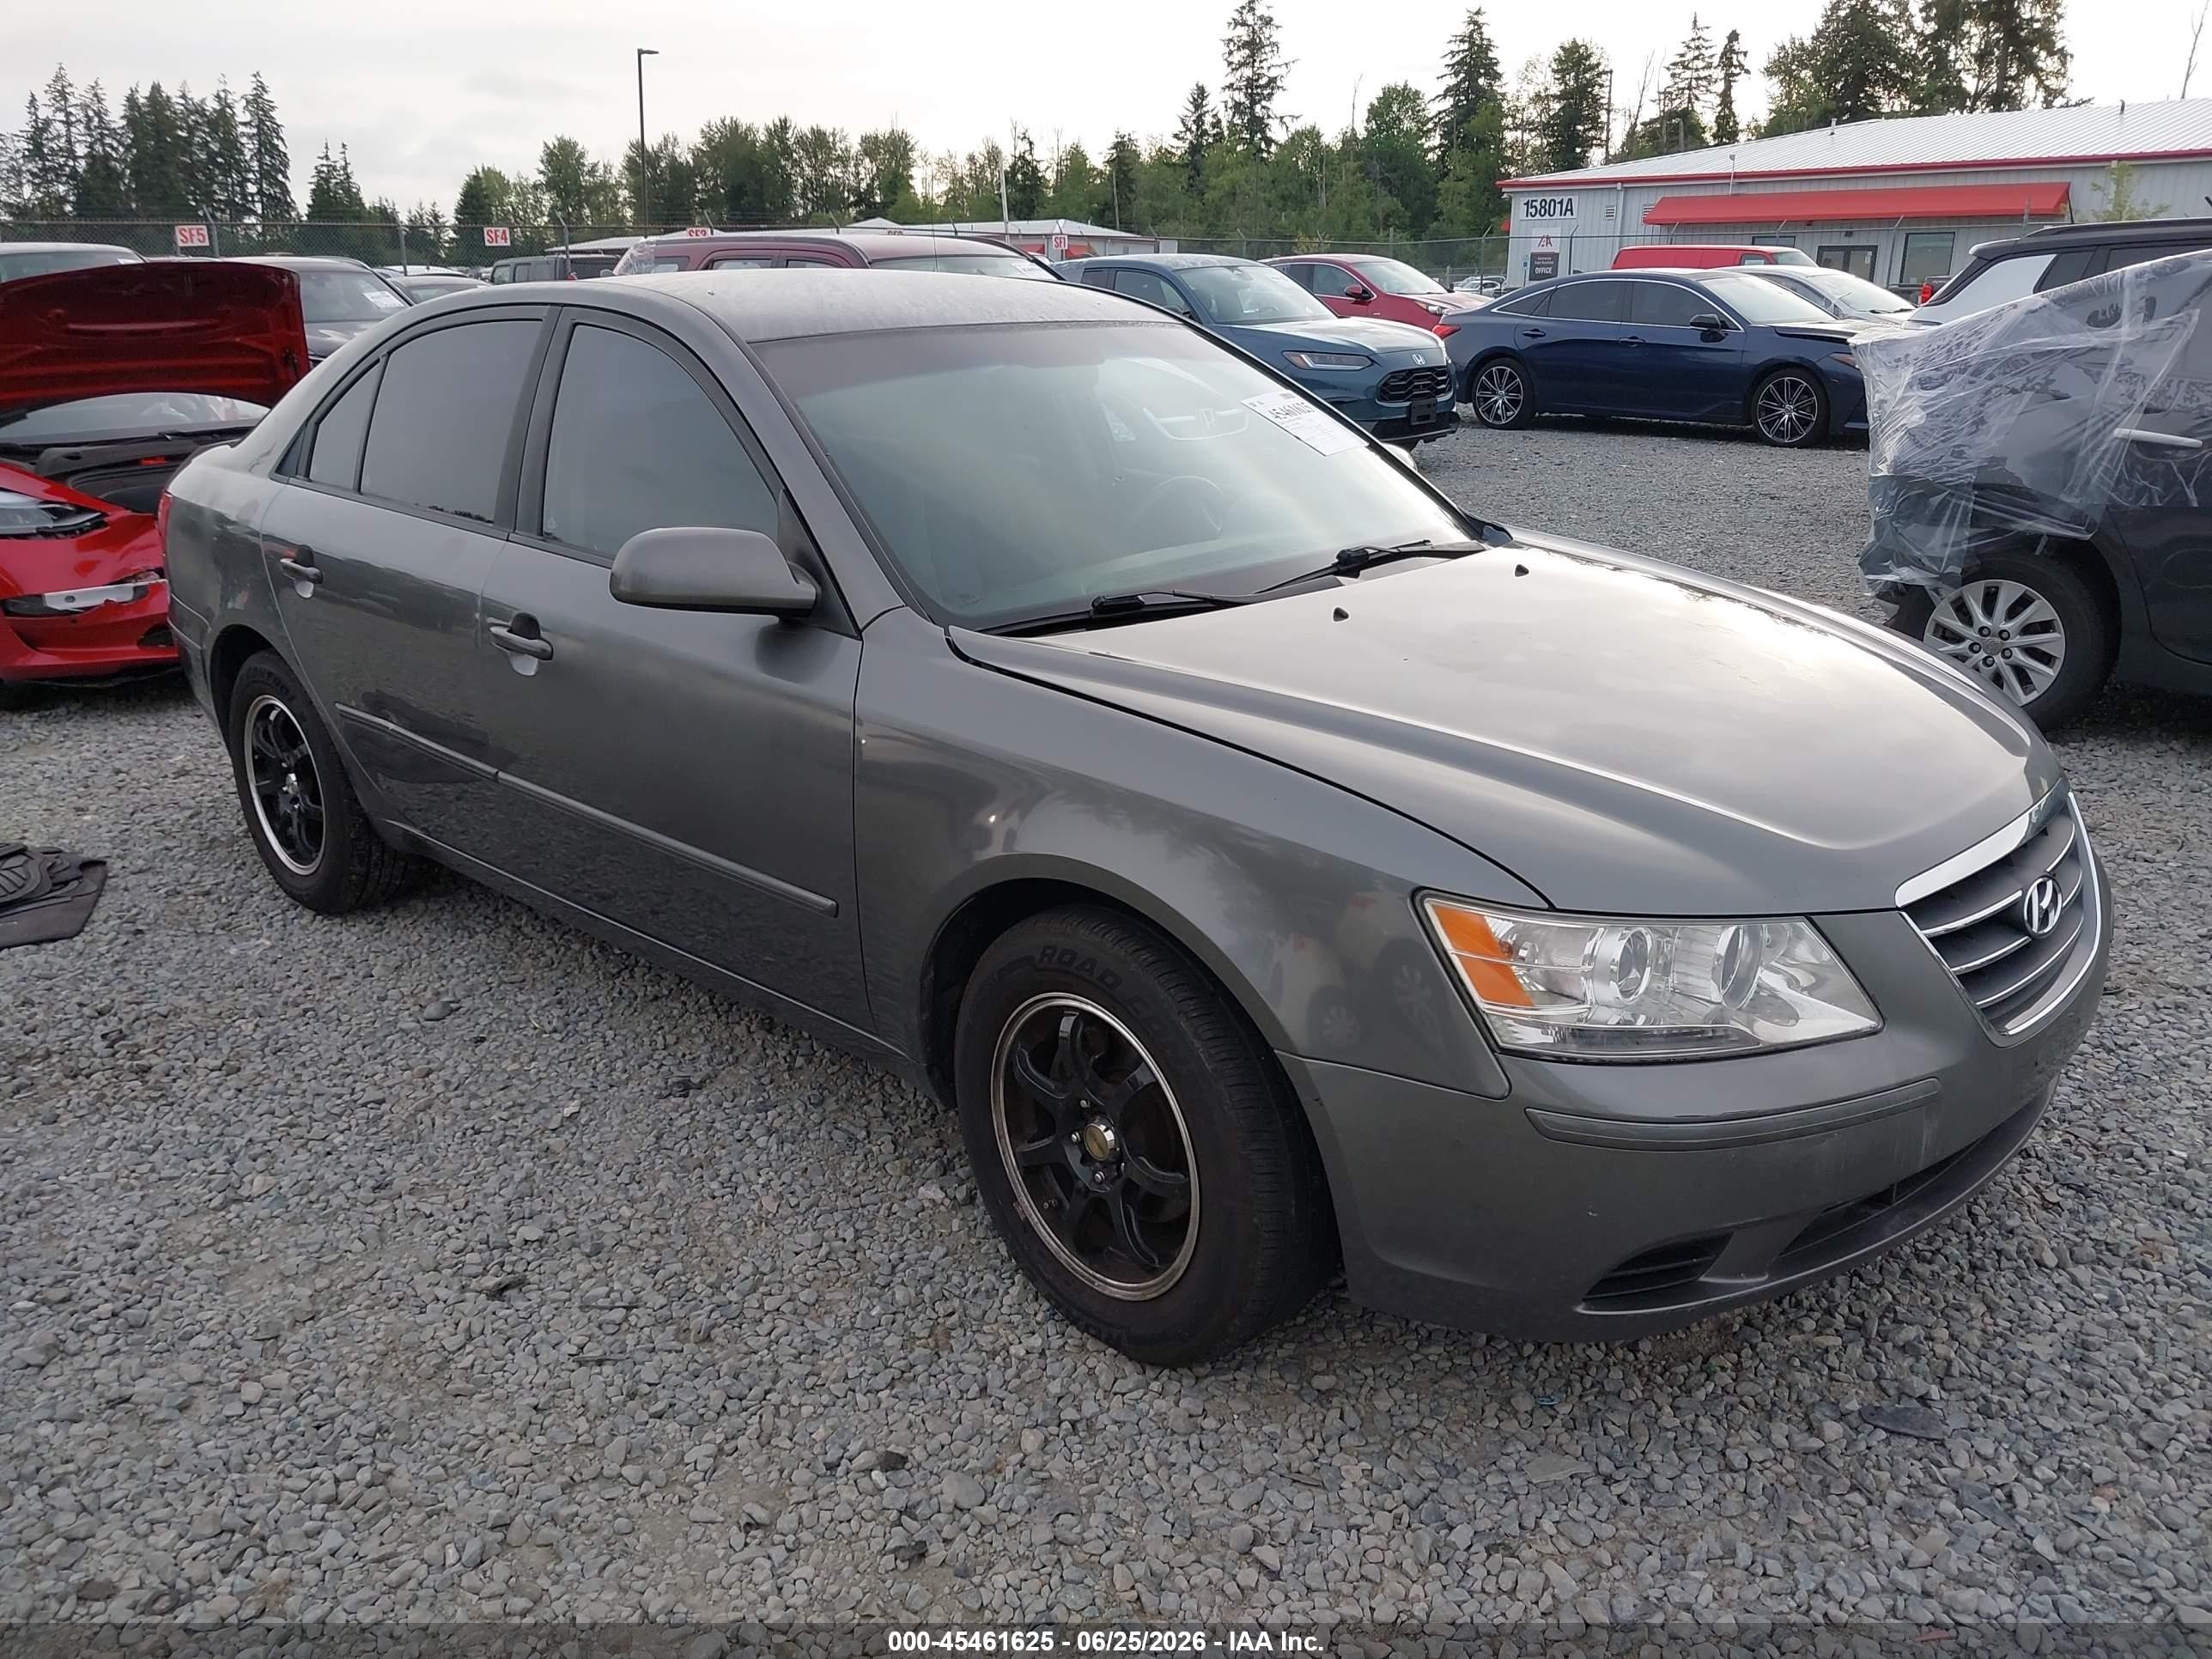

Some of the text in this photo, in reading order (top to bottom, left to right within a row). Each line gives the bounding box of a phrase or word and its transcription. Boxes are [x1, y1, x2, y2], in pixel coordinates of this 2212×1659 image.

[1522, 198, 1574, 218] 15801A
[178, 228, 206, 244] SF5
[486, 228, 508, 244] SF4
[1054, 236, 1066, 248] SF1
[1534, 266, 1553, 275] OFFICE
[1039, 945, 1124, 990] ROAD
